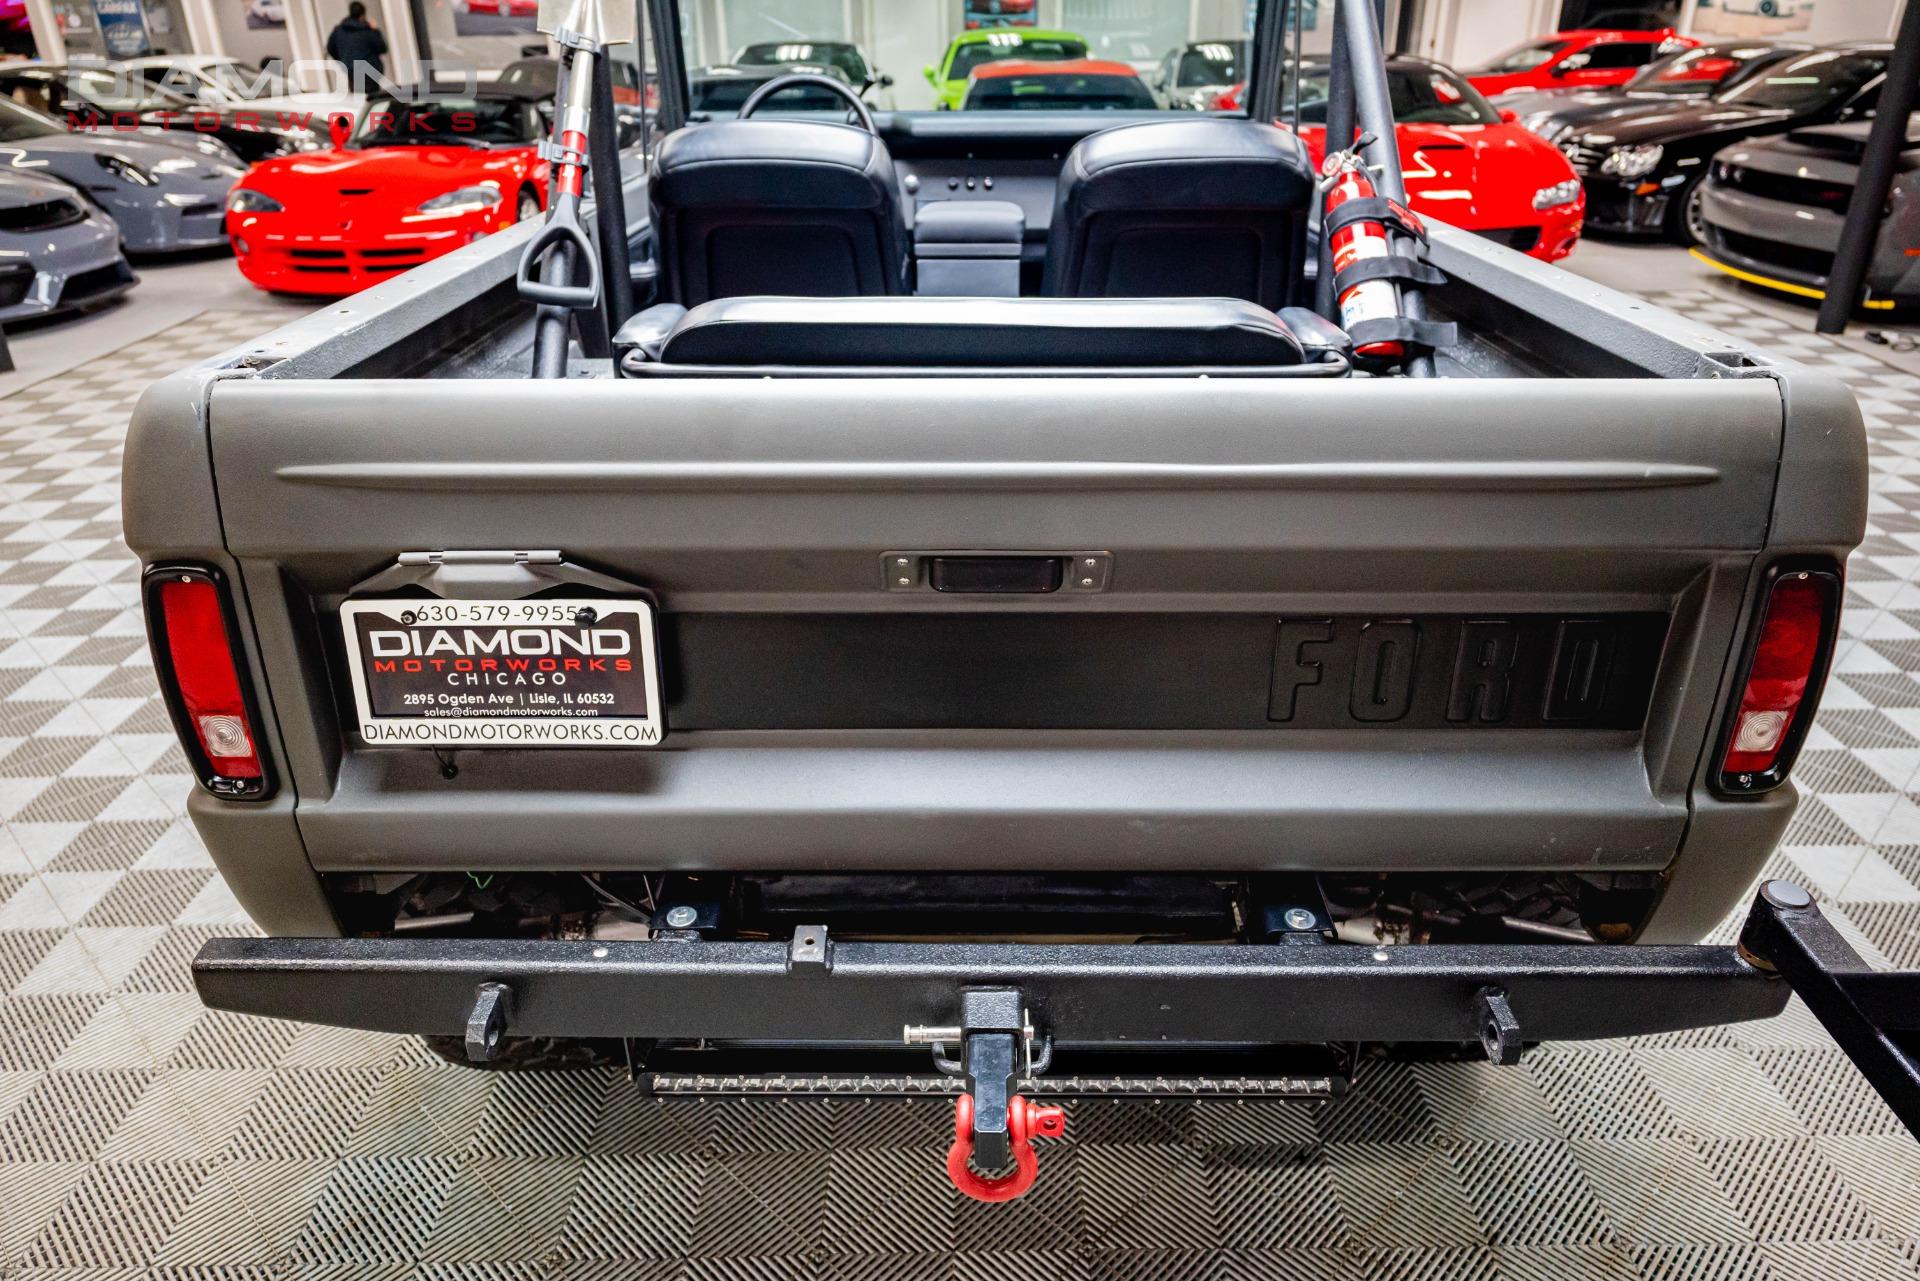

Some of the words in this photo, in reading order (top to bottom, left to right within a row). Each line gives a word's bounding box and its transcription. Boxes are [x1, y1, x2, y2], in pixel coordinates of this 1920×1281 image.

[416, 605, 577, 622] 630-579-9955
[369, 629, 631, 657] DIAMOND
[374, 658, 632, 673] MOTORWORKS
[1267, 618, 1616, 722] FORD
[447, 672, 566, 686] CHICAGO
[403, 694, 434, 705] 2895
[438, 693, 484, 707] Ogden
[488, 693, 514, 705] Ave
[529, 693, 560, 706] Lisle,
[563, 693, 574, 705] IL
[577, 693, 615, 705] 60532
[424, 706, 598, 717] sales@diamondmotorworks.com
[364, 724, 658, 741] DIAMONDMOTORWORKS.COM
